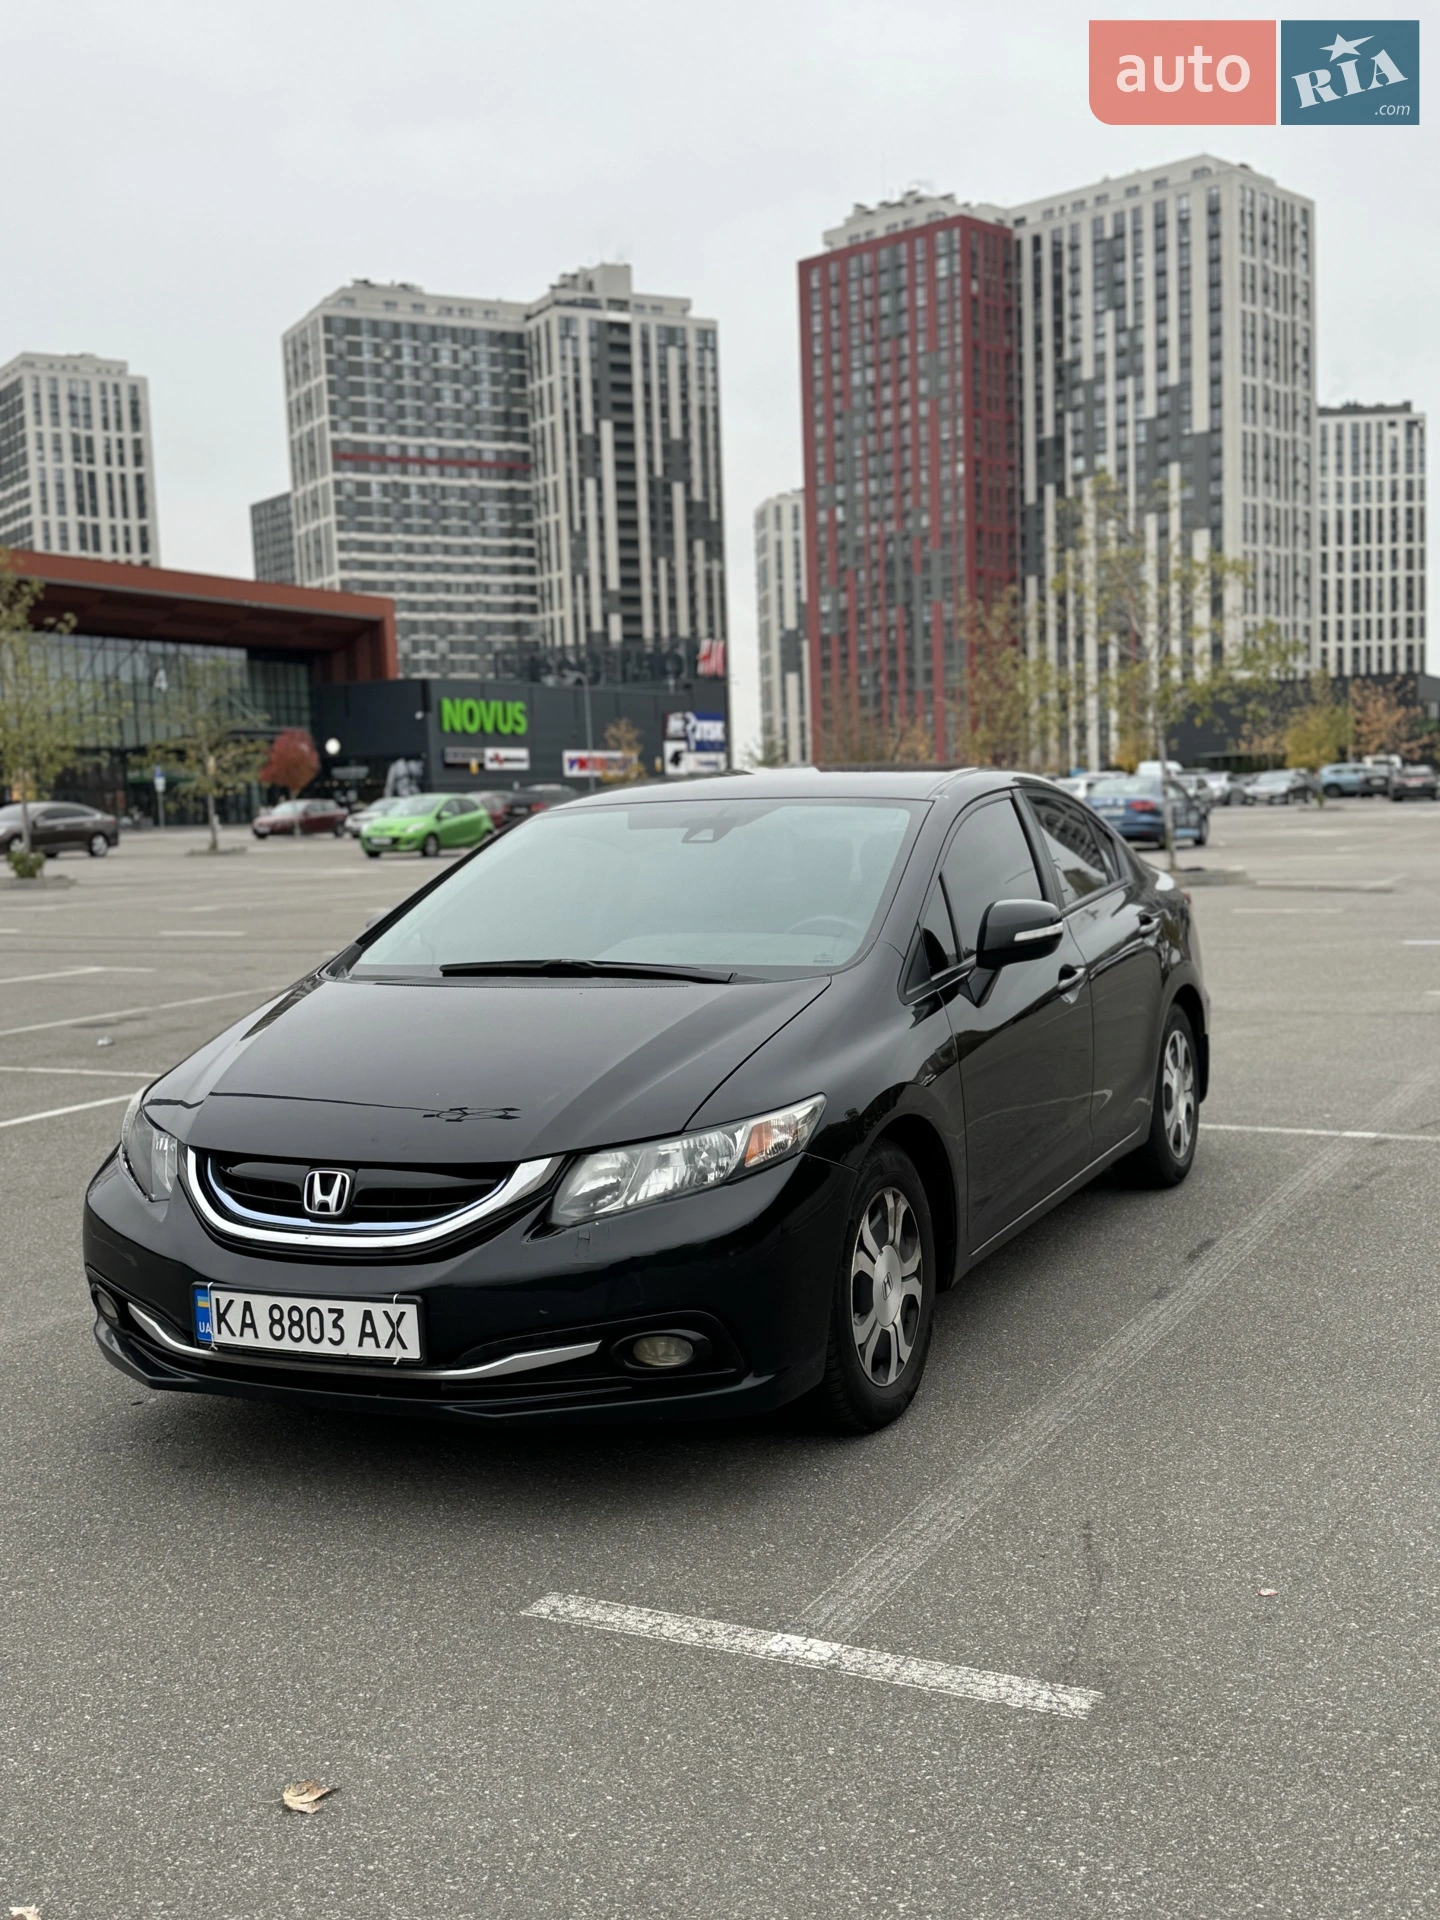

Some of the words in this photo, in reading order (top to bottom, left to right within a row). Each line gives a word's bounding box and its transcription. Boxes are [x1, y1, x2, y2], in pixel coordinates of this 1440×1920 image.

[440, 697, 528, 735] NOVUS
[198, 1321, 212, 1334] UA
[215, 1298, 260, 1339] KA
[268, 1303, 345, 1346] 8803
[357, 1309, 409, 1350] AX
